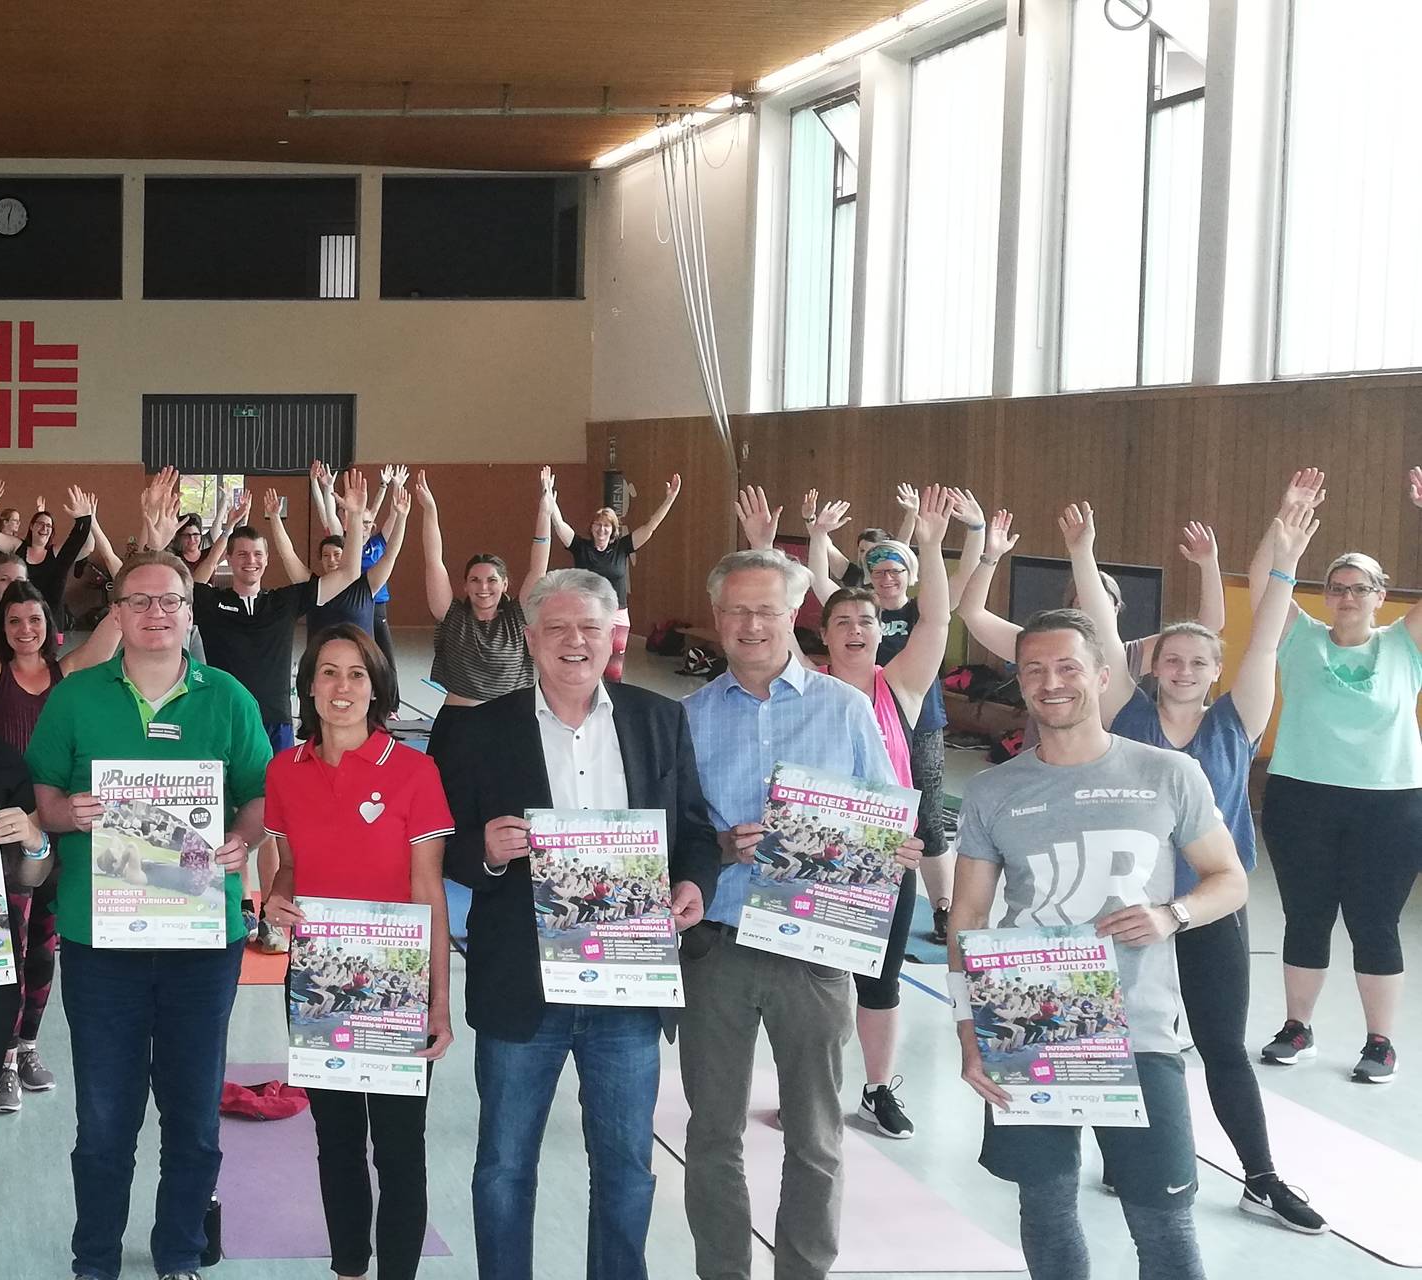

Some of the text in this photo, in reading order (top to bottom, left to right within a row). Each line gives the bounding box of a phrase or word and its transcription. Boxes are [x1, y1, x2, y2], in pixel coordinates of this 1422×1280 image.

[99, 769, 214, 787] Rudelturnen
[101, 786, 211, 799] SIEGEN TURNT!
[1075, 789, 1157, 799] GAYKO
[778, 789, 903, 819] DER KREIS TURNT!
[855, 815, 877, 824] JULI
[880, 820, 903, 829] 2019
[536, 834, 654, 846] DER KREIS TURNT!
[302, 925, 418, 937] DER KREIS TURNT!
[972, 949, 1101, 968] DER KREIS TURNT!
